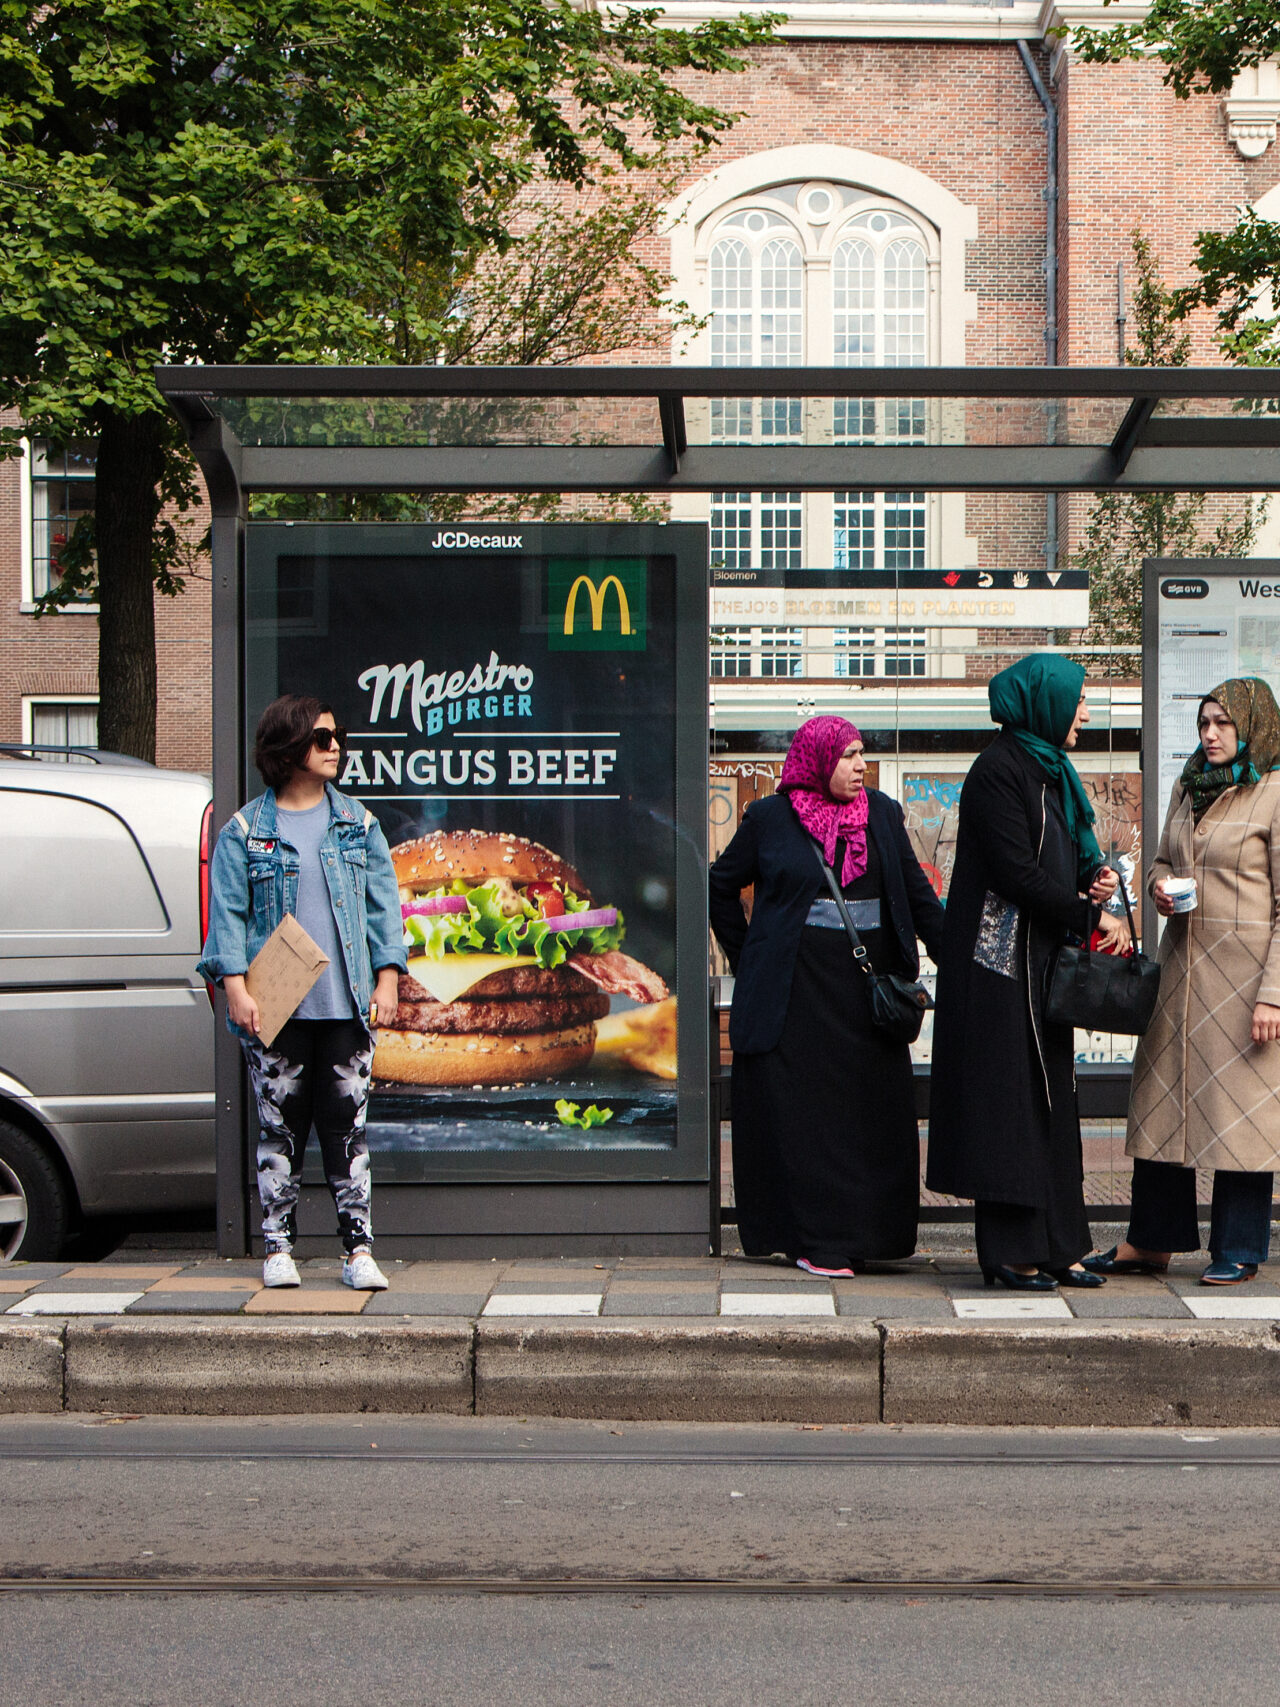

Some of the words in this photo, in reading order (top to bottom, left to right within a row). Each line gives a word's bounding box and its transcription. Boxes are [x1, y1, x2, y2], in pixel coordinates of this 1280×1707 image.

[431, 532, 523, 549] JCDecaux
[714, 570, 757, 580] Bloemen
[785, 600, 881, 616] BLOEMEN
[888, 600, 916, 616] EN
[922, 600, 1016, 616] PLANTEN
[357, 650, 534, 732] Maestro
[426, 693, 533, 736] BURGER
[338, 749, 497, 786] ANGUS
[508, 749, 617, 785] BEEF
